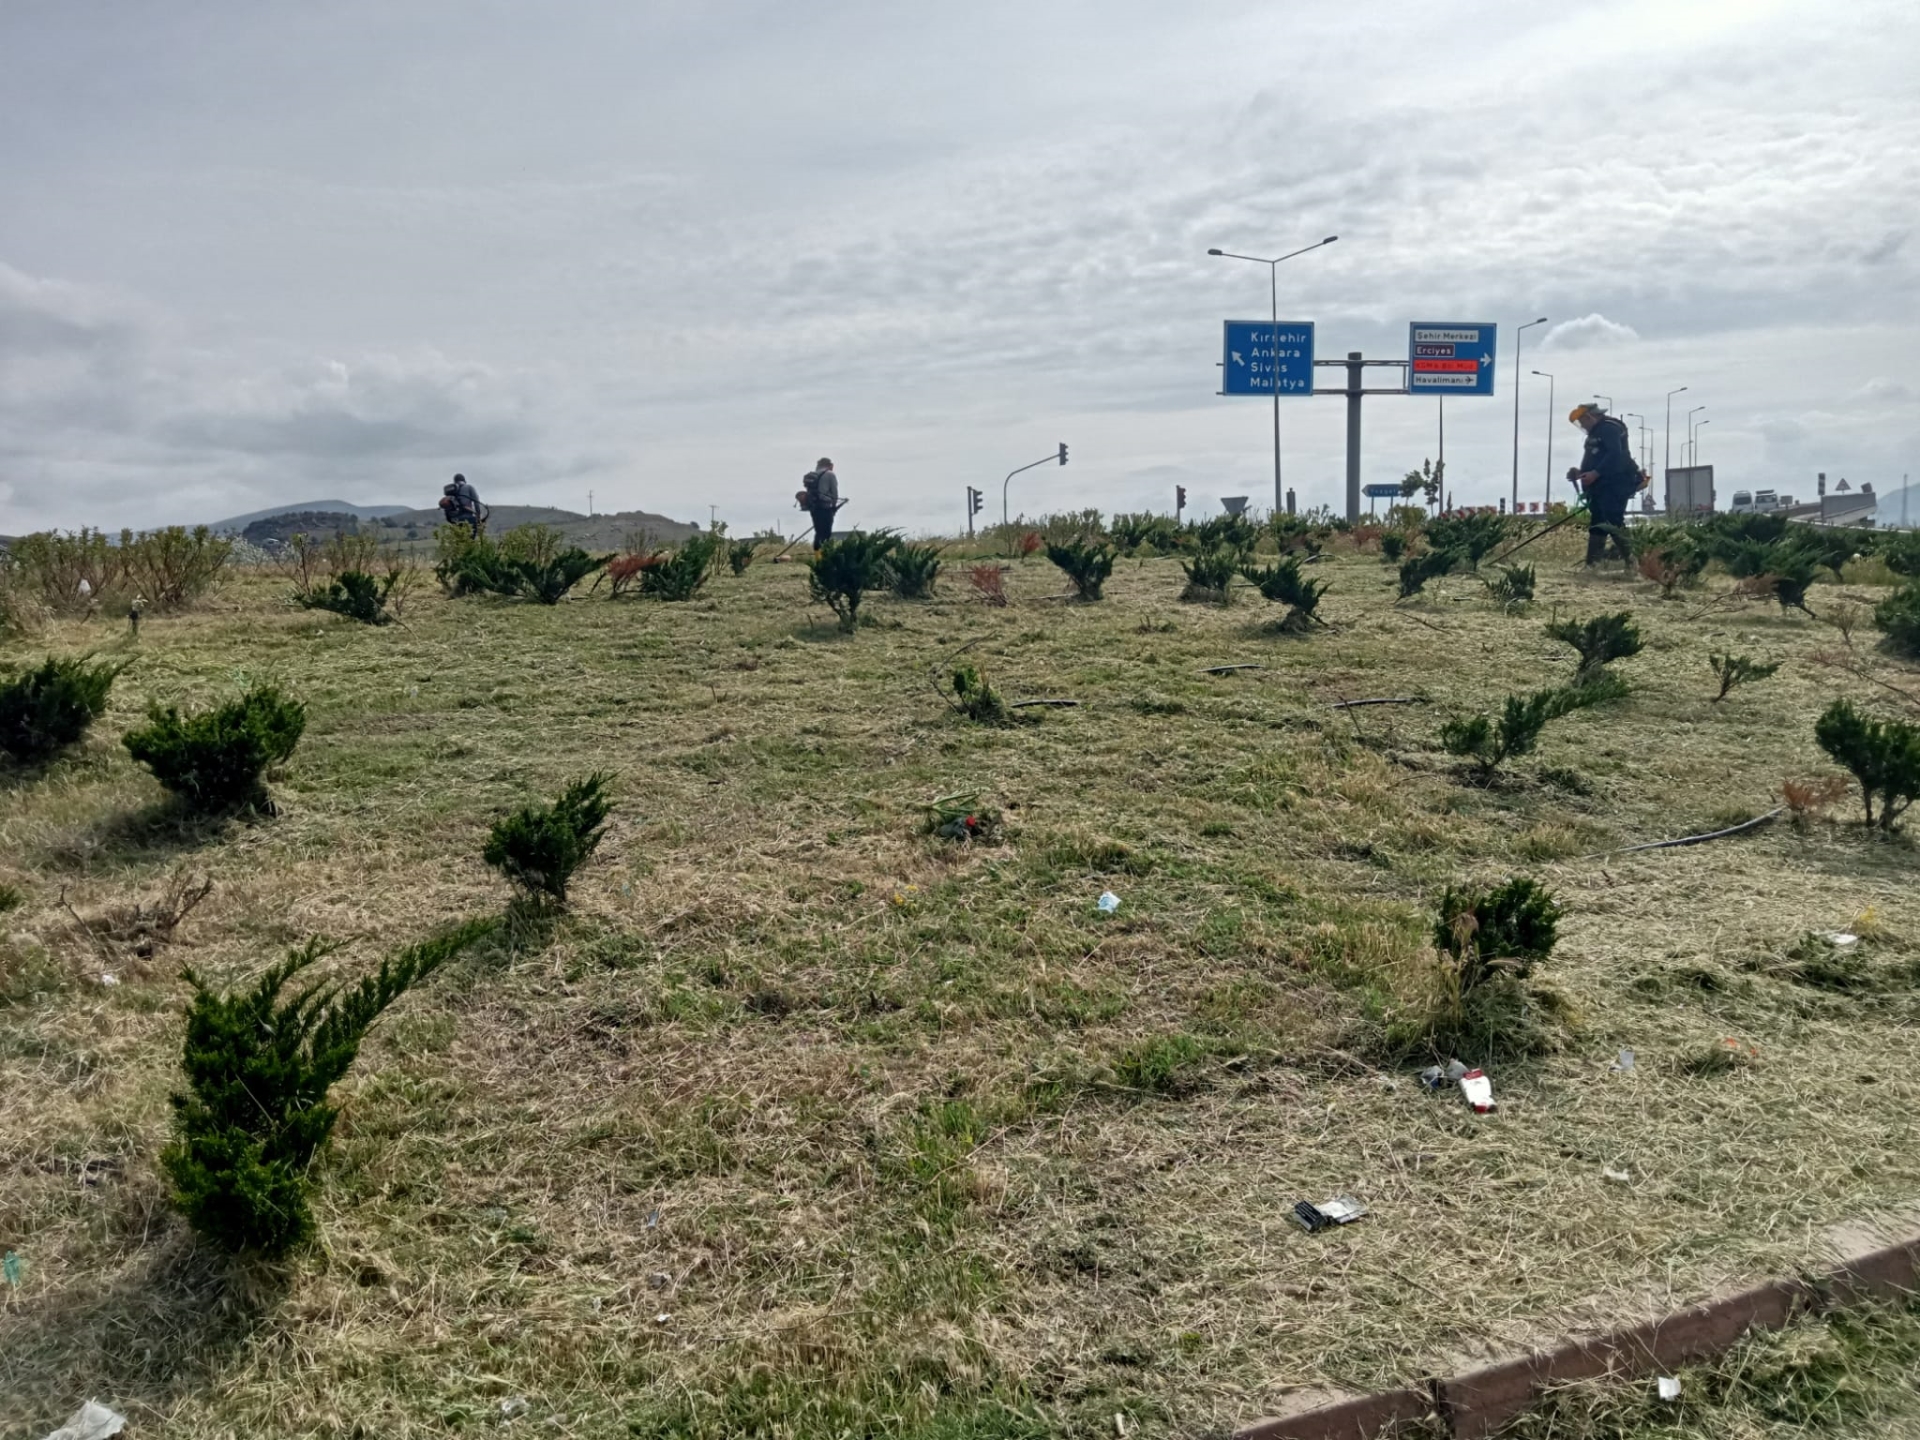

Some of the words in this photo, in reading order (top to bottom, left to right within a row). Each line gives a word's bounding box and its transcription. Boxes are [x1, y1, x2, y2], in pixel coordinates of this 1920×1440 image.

[1443, 332, 1477, 340] Merkezi
[1251, 347, 1301, 358] Ankara
[1416, 346, 1451, 356] Erciyes
[1251, 362, 1288, 373] Sivas
